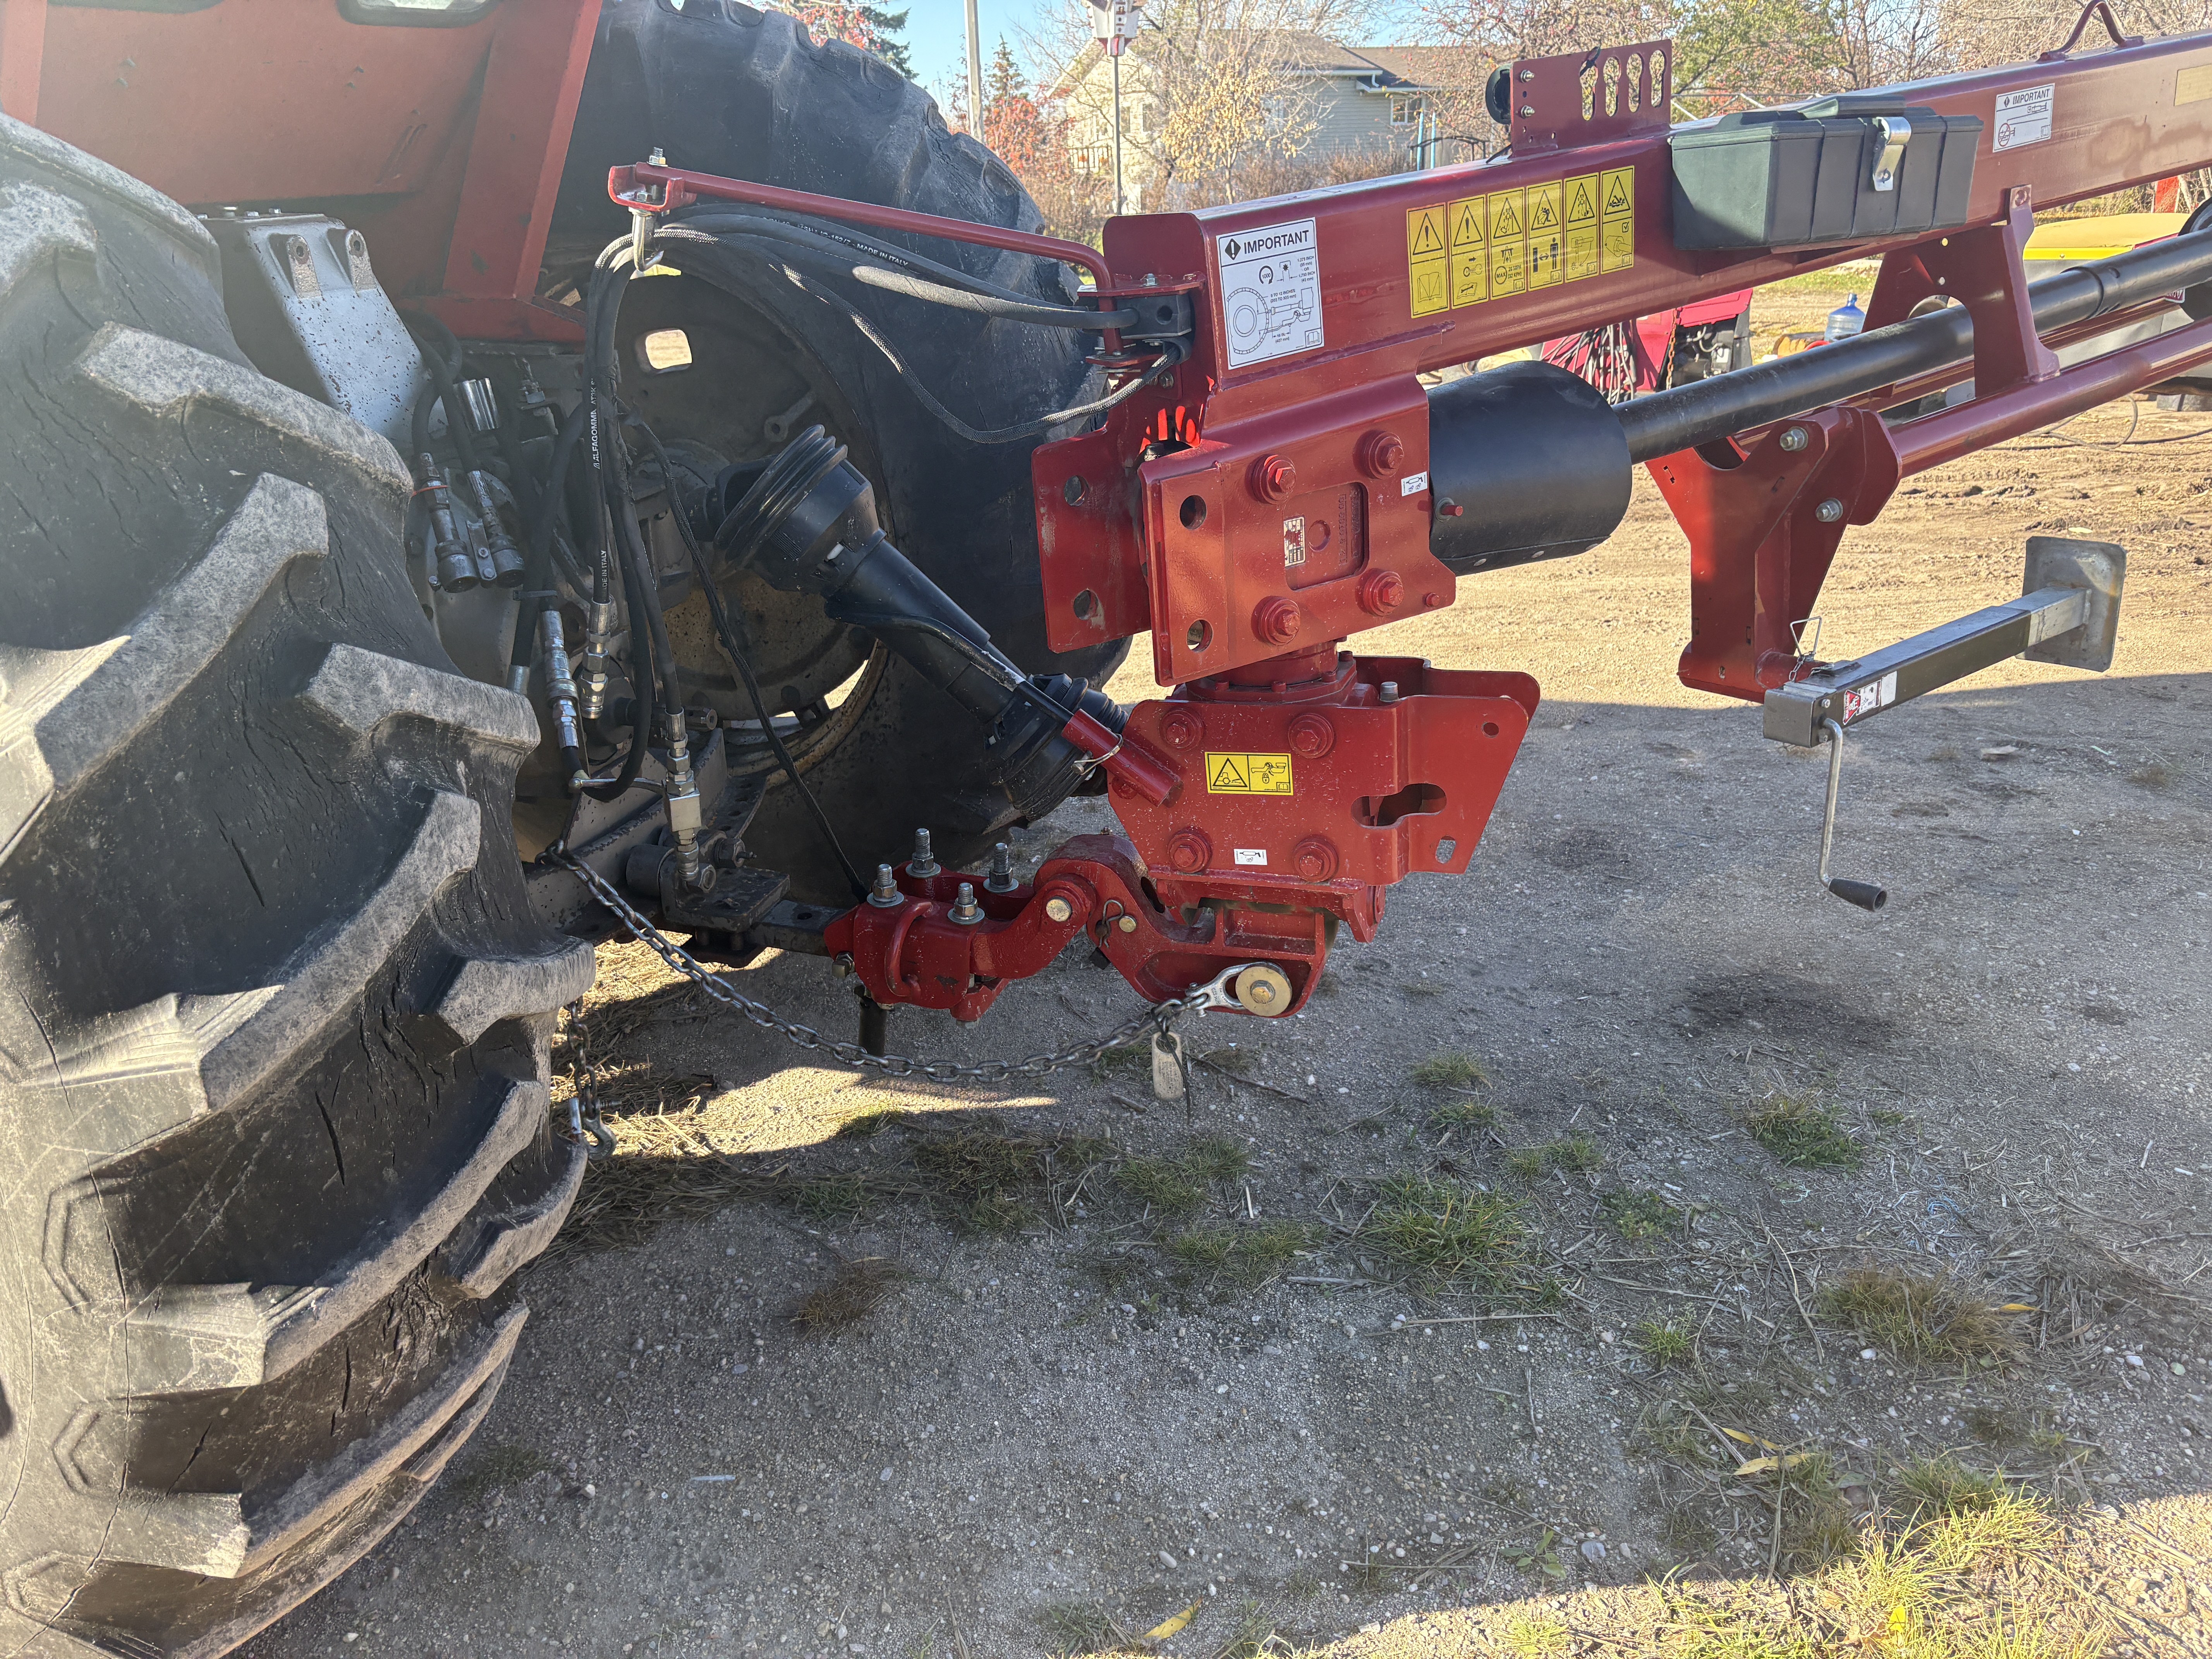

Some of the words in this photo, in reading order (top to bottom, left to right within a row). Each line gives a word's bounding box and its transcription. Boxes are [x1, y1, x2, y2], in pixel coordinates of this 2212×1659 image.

[2013, 88, 2050, 105] IMPORTANT
[1244, 230, 1309, 254] IMPORTANT
[857, 243, 878, 255] MADE
[889, 255, 908, 266] ITALY
[591, 409, 599, 462] ALFAGOMMA
